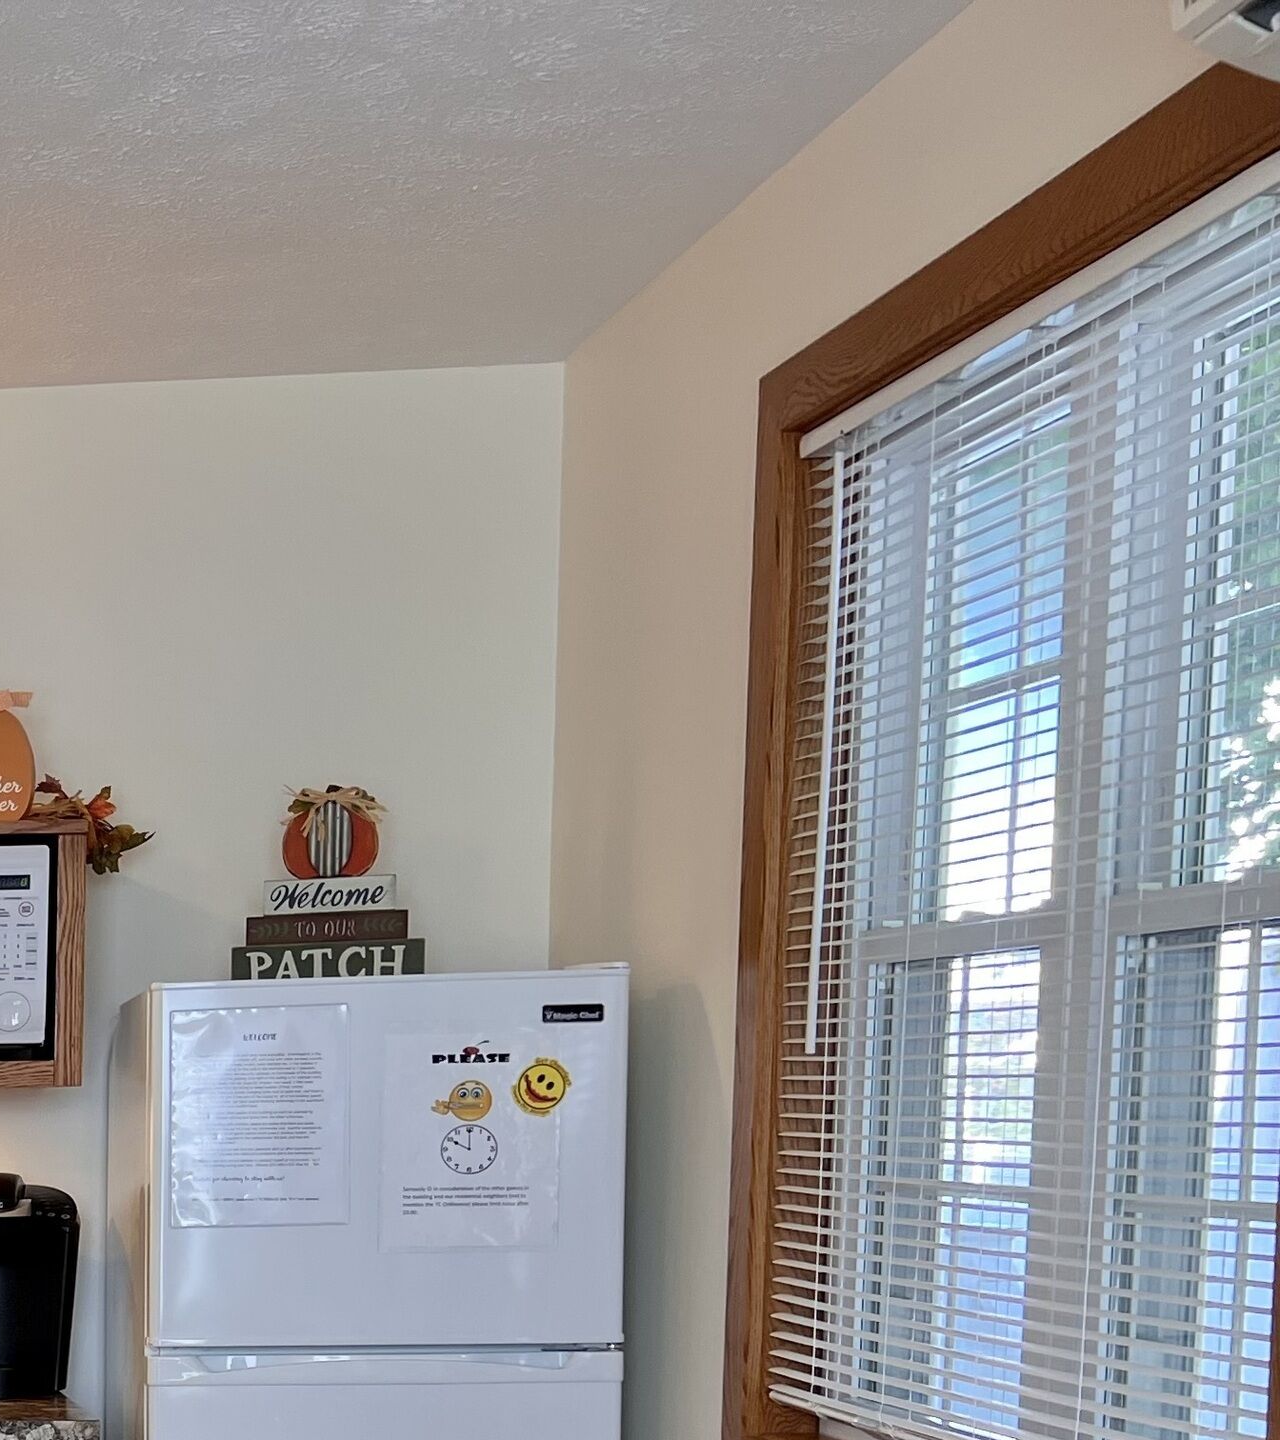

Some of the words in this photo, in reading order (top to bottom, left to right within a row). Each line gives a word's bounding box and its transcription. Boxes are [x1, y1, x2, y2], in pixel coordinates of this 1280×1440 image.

[270, 882, 389, 912] Welcome
[293, 920, 316, 938] TO
[324, 918, 357, 938] OUR
[245, 944, 407, 980] PATCH
[431, 1053, 511, 1064] PLEASE
